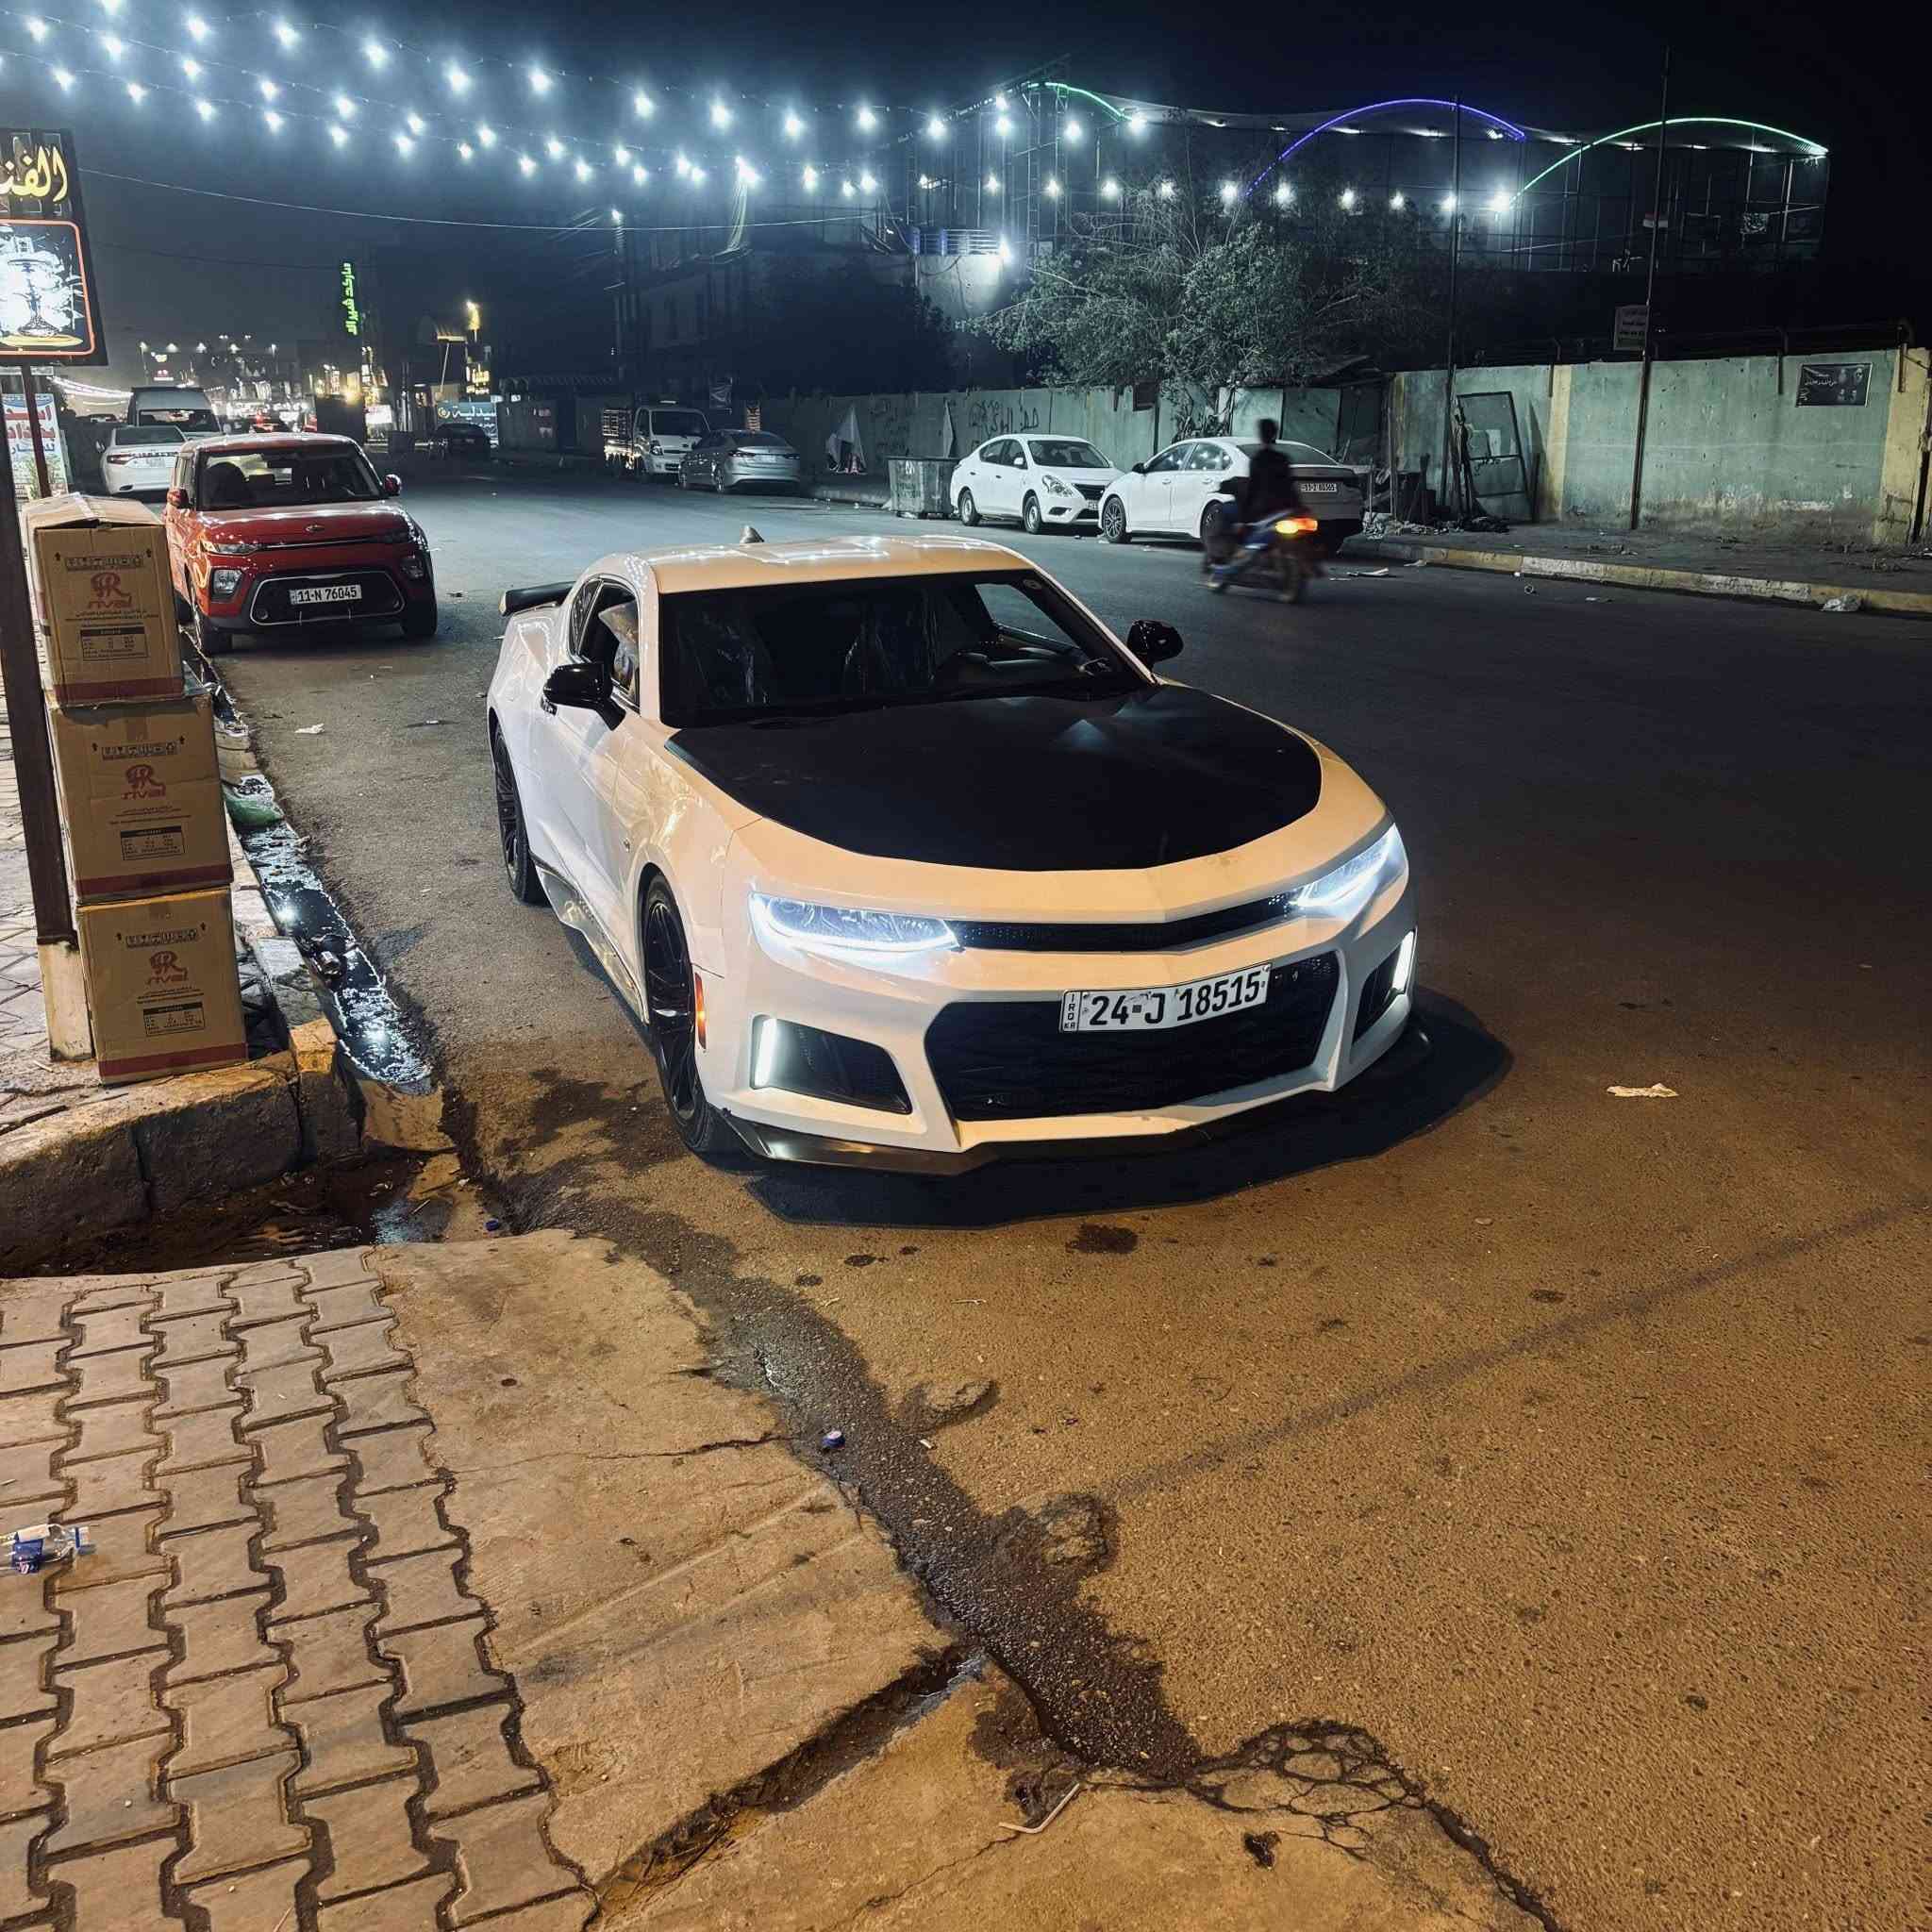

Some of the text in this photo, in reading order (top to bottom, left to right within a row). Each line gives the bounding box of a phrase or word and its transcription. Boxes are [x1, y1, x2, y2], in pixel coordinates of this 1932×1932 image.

[0, 145, 68, 202] الفن
[325, 586, 358, 599] 76045
[1176, 971, 1261, 1022] 18515
